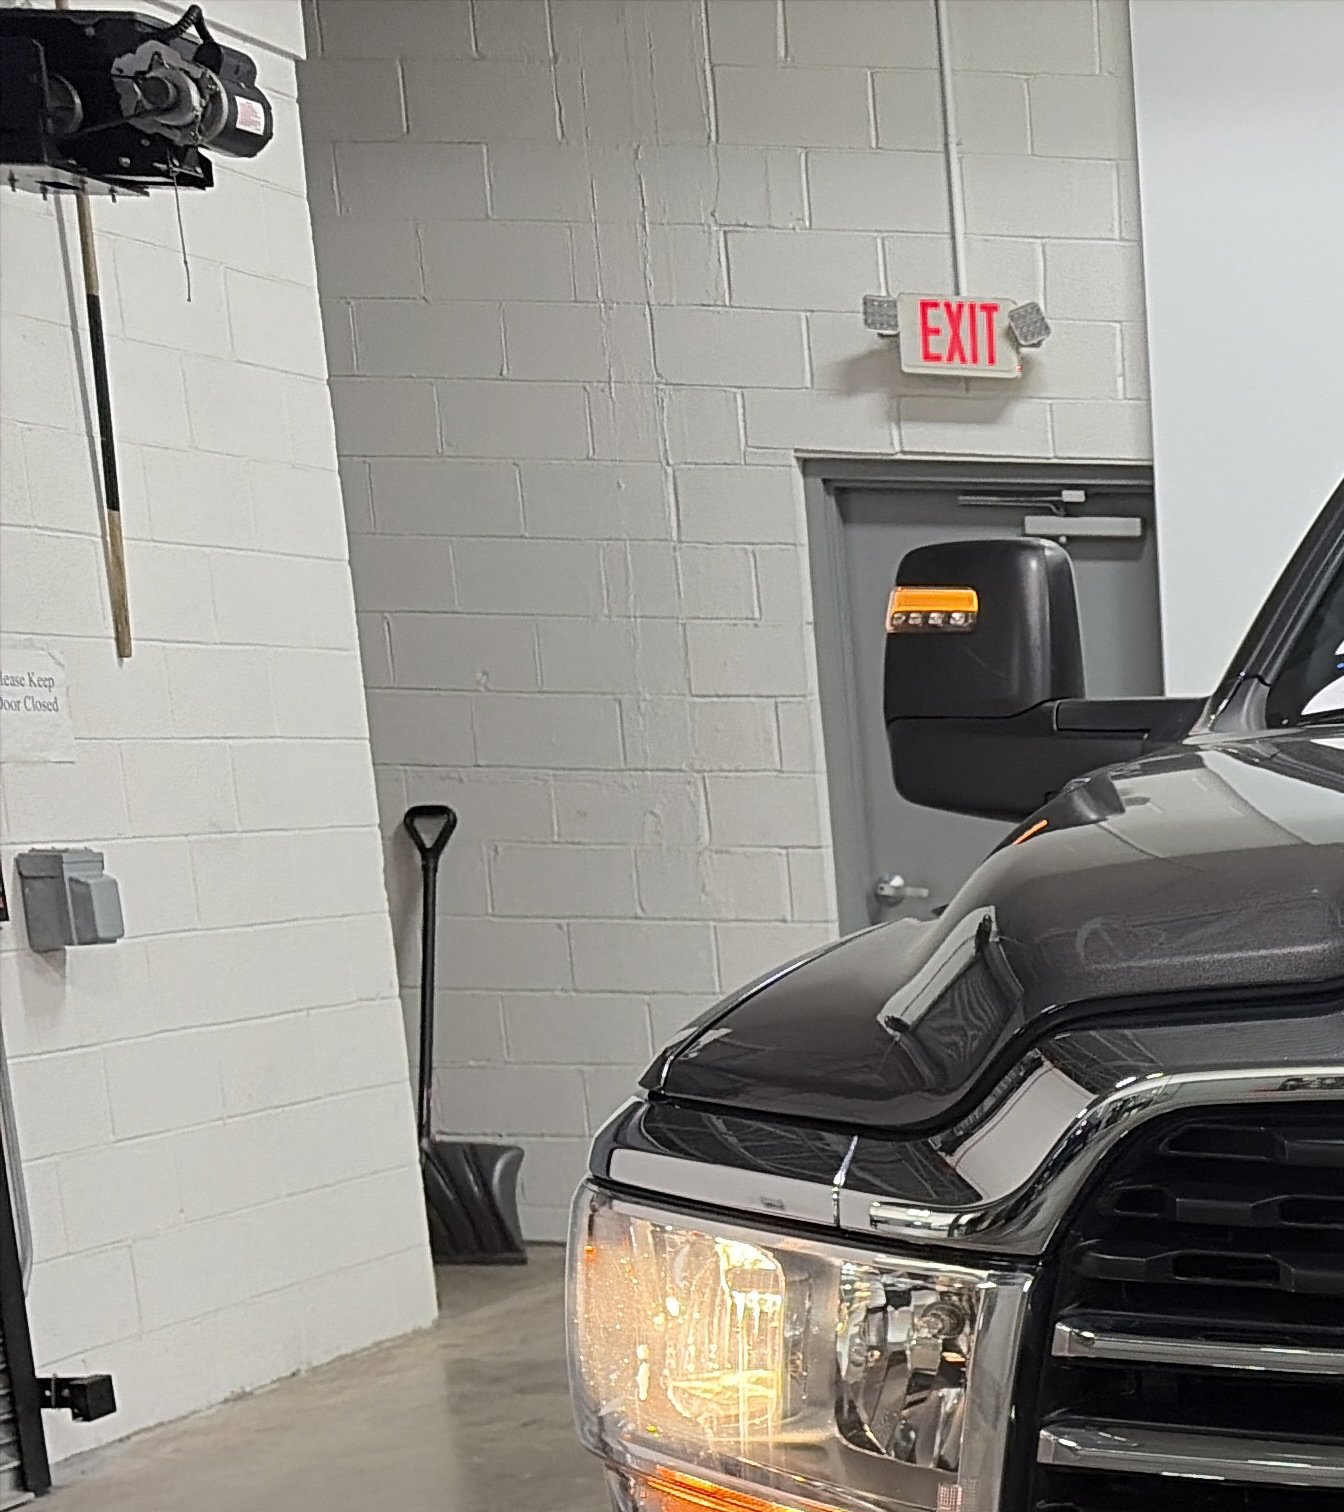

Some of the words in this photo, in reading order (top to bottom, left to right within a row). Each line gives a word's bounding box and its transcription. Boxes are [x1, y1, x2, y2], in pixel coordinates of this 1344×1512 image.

[919, 300, 999, 366] EXIT
[0, 671, 25, 688] lease
[27, 671, 55, 693] Keep
[23, 695, 60, 713] Closed
